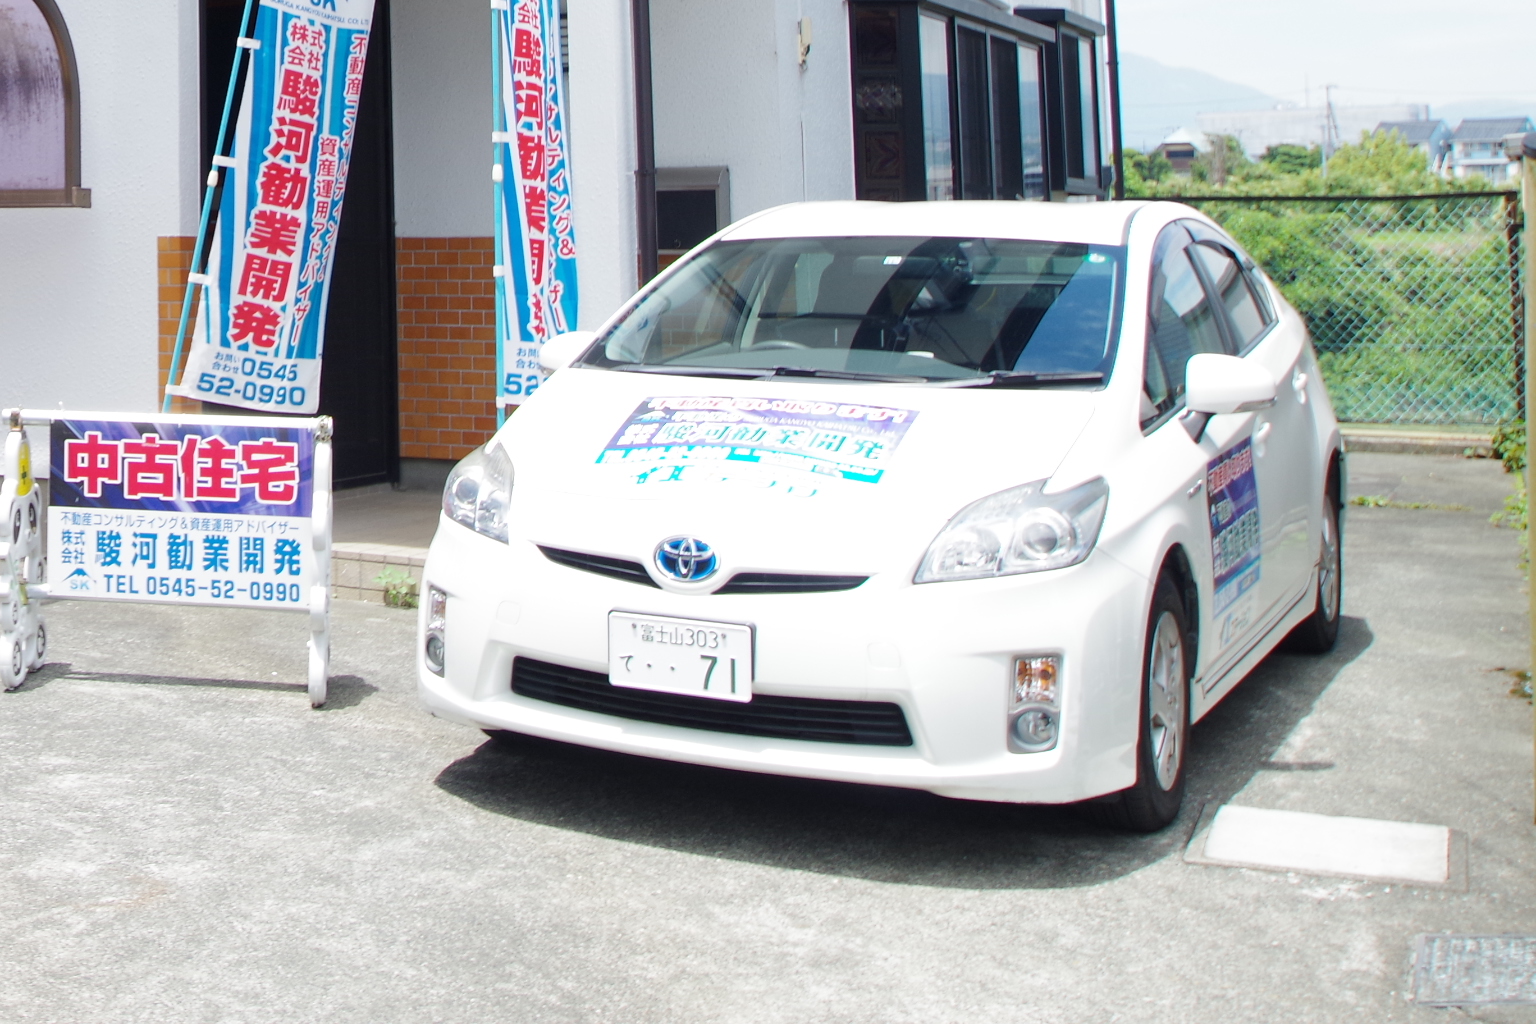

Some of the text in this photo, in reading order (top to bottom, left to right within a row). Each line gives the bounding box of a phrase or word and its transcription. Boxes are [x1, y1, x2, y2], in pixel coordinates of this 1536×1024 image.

[230, 68, 320, 348] 駿河勧業開発
[242, 358, 297, 381] 0545
[197, 373, 305, 406] 52-0990
[66, 432, 298, 504] 中古住宅
[95, 530, 302, 576] 駿河勧業開発
[70, 579, 90, 590] SK
[104, 574, 300, 603] TEL 0545-52-0990
